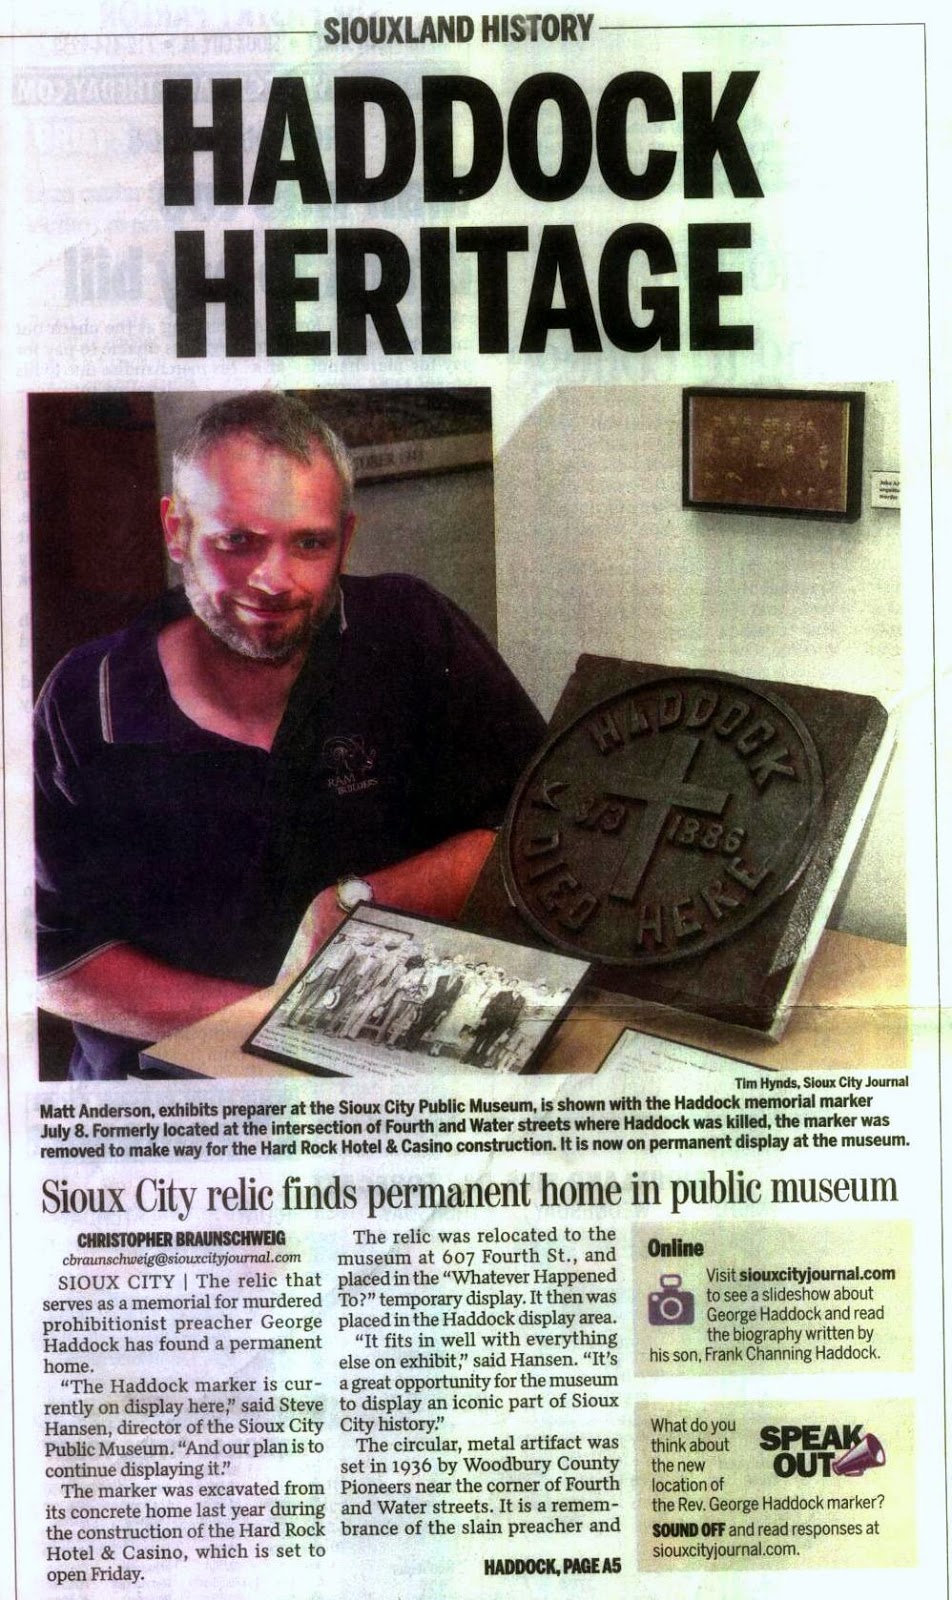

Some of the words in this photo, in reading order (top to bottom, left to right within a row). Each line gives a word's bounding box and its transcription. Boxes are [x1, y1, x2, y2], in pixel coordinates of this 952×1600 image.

[324, 16, 474, 45] SIOUXLAND
[482, 14, 594, 42] HISTORY
[162, 71, 764, 206] HADDOCK
[174, 222, 754, 358] HERITAGE
[591, 689, 795, 787] HADDOCK
[668, 814, 744, 852] 1886
[522, 830, 599, 929] DIED
[637, 857, 770, 945] HERE
[735, 1078, 757, 1089] Tim
[761, 1077, 800, 1091] Hynds,
[804, 1077, 836, 1088] Sioux
[839, 1076, 862, 1090] City
[865, 1075, 909, 1087] Journal
[40, 1104, 75, 1119] Matt
[79, 1104, 155, 1118] Anderson,
[159, 1102, 218, 1117] exhibits
[223, 1105, 287, 1119] preparer
[291, 1101, 306, 1115] at
[310, 1101, 334, 1115] the
[339, 1100, 381, 1114] Sioux
[385, 1099, 415, 1117] City
[419, 1099, 465, 1113] Public
[470, 1098, 537, 1113] Museum,
[541, 1098, 554, 1112] is
[558, 1097, 605, 1111] shown
[609, 1096, 641, 1110] with
[645, 1096, 670, 1110] the
[675, 1095, 740, 1109] Haddock
[745, 1094, 815, 1108] memorial
[820, 1093, 873, 1108] marker
[41, 1143, 105, 1158] removed
[109, 1144, 125, 1157] to
[129, 1143, 170, 1157] make
[173, 1146, 202, 1160] way
[206, 1142, 228, 1156] for
[232, 1141, 257, 1156] the
[261, 1141, 296, 1155] Hard
[301, 1140, 337, 1154] Rock
[342, 1139, 382, 1154] Hotel
[386, 1139, 398, 1154] &
[402, 1139, 452, 1153] Casino
[456, 1137, 556, 1152] construction.
[561, 1137, 572, 1151] It
[576, 1137, 588, 1151] is
[593, 1139, 623, 1150] now
[627, 1139, 645, 1150] on
[650, 1135, 732, 1153] permanent
[736, 1134, 789, 1152] display
[793, 1134, 809, 1147] at
[813, 1133, 837, 1147] the
[842, 1135, 910, 1147] museum.
[42, 1179, 126, 1214] Sioux
[136, 1178, 197, 1221] City
[207, 1177, 273, 1211] relic
[282, 1175, 357, 1210] finds
[367, 1174, 530, 1218] permanent
[540, 1172, 622, 1206] home
[631, 1172, 661, 1205] in
[670, 1170, 761, 1214] public
[771, 1178, 899, 1203] museum
[77, 1232, 173, 1248] CHRISTOPHER
[176, 1230, 286, 1246] BRAUNSCHWEIG
[648, 1238, 704, 1257] Online
[63, 1251, 301, 1267] cbraunschweig@siouxcityjournal.com
[337, 1254, 411, 1265] museum
[419, 1250, 435, 1264] at
[443, 1250, 474, 1266] 607
[482, 1248, 540, 1263] Fourth
[548, 1248, 577, 1265] St.,
[585, 1247, 616, 1262] and
[59, 1276, 119, 1290] SIOUX
[128, 1275, 175, 1289] CITY
[196, 1273, 230, 1288] The
[238, 1273, 277, 1287] relic
[286, 1272, 321, 1287] that
[706, 1268, 736, 1282] Visit
[740, 1266, 896, 1284] siouxcityjournal.com
[707, 1288, 720, 1302] to
[724, 1291, 747, 1302] see
[751, 1291, 758, 1301] a
[763, 1287, 830, 1301] slideshow
[834, 1286, 873, 1300] about
[707, 1307, 756, 1324] George
[761, 1306, 821, 1321] Haddock
[825, 1306, 850, 1320] and
[854, 1305, 884, 1320] read
[43, 1316, 166, 1336] prohibitionist
[175, 1315, 252, 1333] preacher
[261, 1315, 322, 1332] George
[707, 1327, 729, 1341] the
[734, 1326, 802, 1344] biography
[806, 1326, 854, 1340] written
[858, 1325, 874, 1343] by
[650, 1348, 670, 1362] his
[673, 1351, 701, 1363] son,
[705, 1347, 743, 1361] Frank
[746, 1346, 812, 1363] Channing
[816, 1345, 880, 1360] Haddock.
[45, 1422, 112, 1437] Hansen,
[117, 1420, 181, 1434] director
[187, 1419, 203, 1434] of
[207, 1419, 233, 1433] the
[239, 1418, 284, 1433] Sioux
[289, 1418, 324, 1436] City
[651, 1418, 687, 1432] What
[691, 1418, 708, 1432] do
[711, 1420, 736, 1435] you
[356, 1437, 388, 1452] The
[394, 1436, 462, 1454] circular,
[468, 1435, 515, 1451] metal
[521, 1435, 581, 1450] artifact
[587, 1438, 619, 1449] was
[651, 1438, 686, 1453] think
[690, 1437, 730, 1452] about
[760, 1425, 863, 1451] SPEAK
[651, 1458, 674, 1473] the
[678, 1461, 705, 1472] new
[773, 1452, 835, 1478] OUT
[341, 1480, 411, 1494] Pioneers
[416, 1482, 451, 1493] near
[456, 1478, 482, 1492] the
[487, 1481, 540, 1492] corner
[545, 1476, 561, 1491] of
[566, 1476, 620, 1491] Fourth
[652, 1478, 707, 1492] location
[711, 1477, 724, 1491] of
[652, 1498, 674, 1512] the
[679, 1497, 706, 1511] Rev.
[709, 1497, 759, 1514] George
[763, 1495, 824, 1510] Haddock
[828, 1494, 885, 1509] marker?
[46, 1525, 72, 1540] the
[77, 1524, 183, 1539] construction
[187, 1523, 203, 1538] of
[208, 1523, 234, 1538] the
[239, 1522, 281, 1537] Hard
[285, 1521, 325, 1536] Rock
[652, 1523, 698, 1538] SOUND
[701, 1522, 726, 1537] OFF
[729, 1522, 754, 1536] and
[758, 1521, 788, 1536] read
[792, 1524, 863, 1539] responses
[866, 1521, 880, 1535] at
[653, 1542, 800, 1560] siouxcityjournal.com.
[484, 1558, 561, 1576] HADDOCK,
[563, 1558, 600, 1574] PAGE
[602, 1557, 622, 1574] A5
